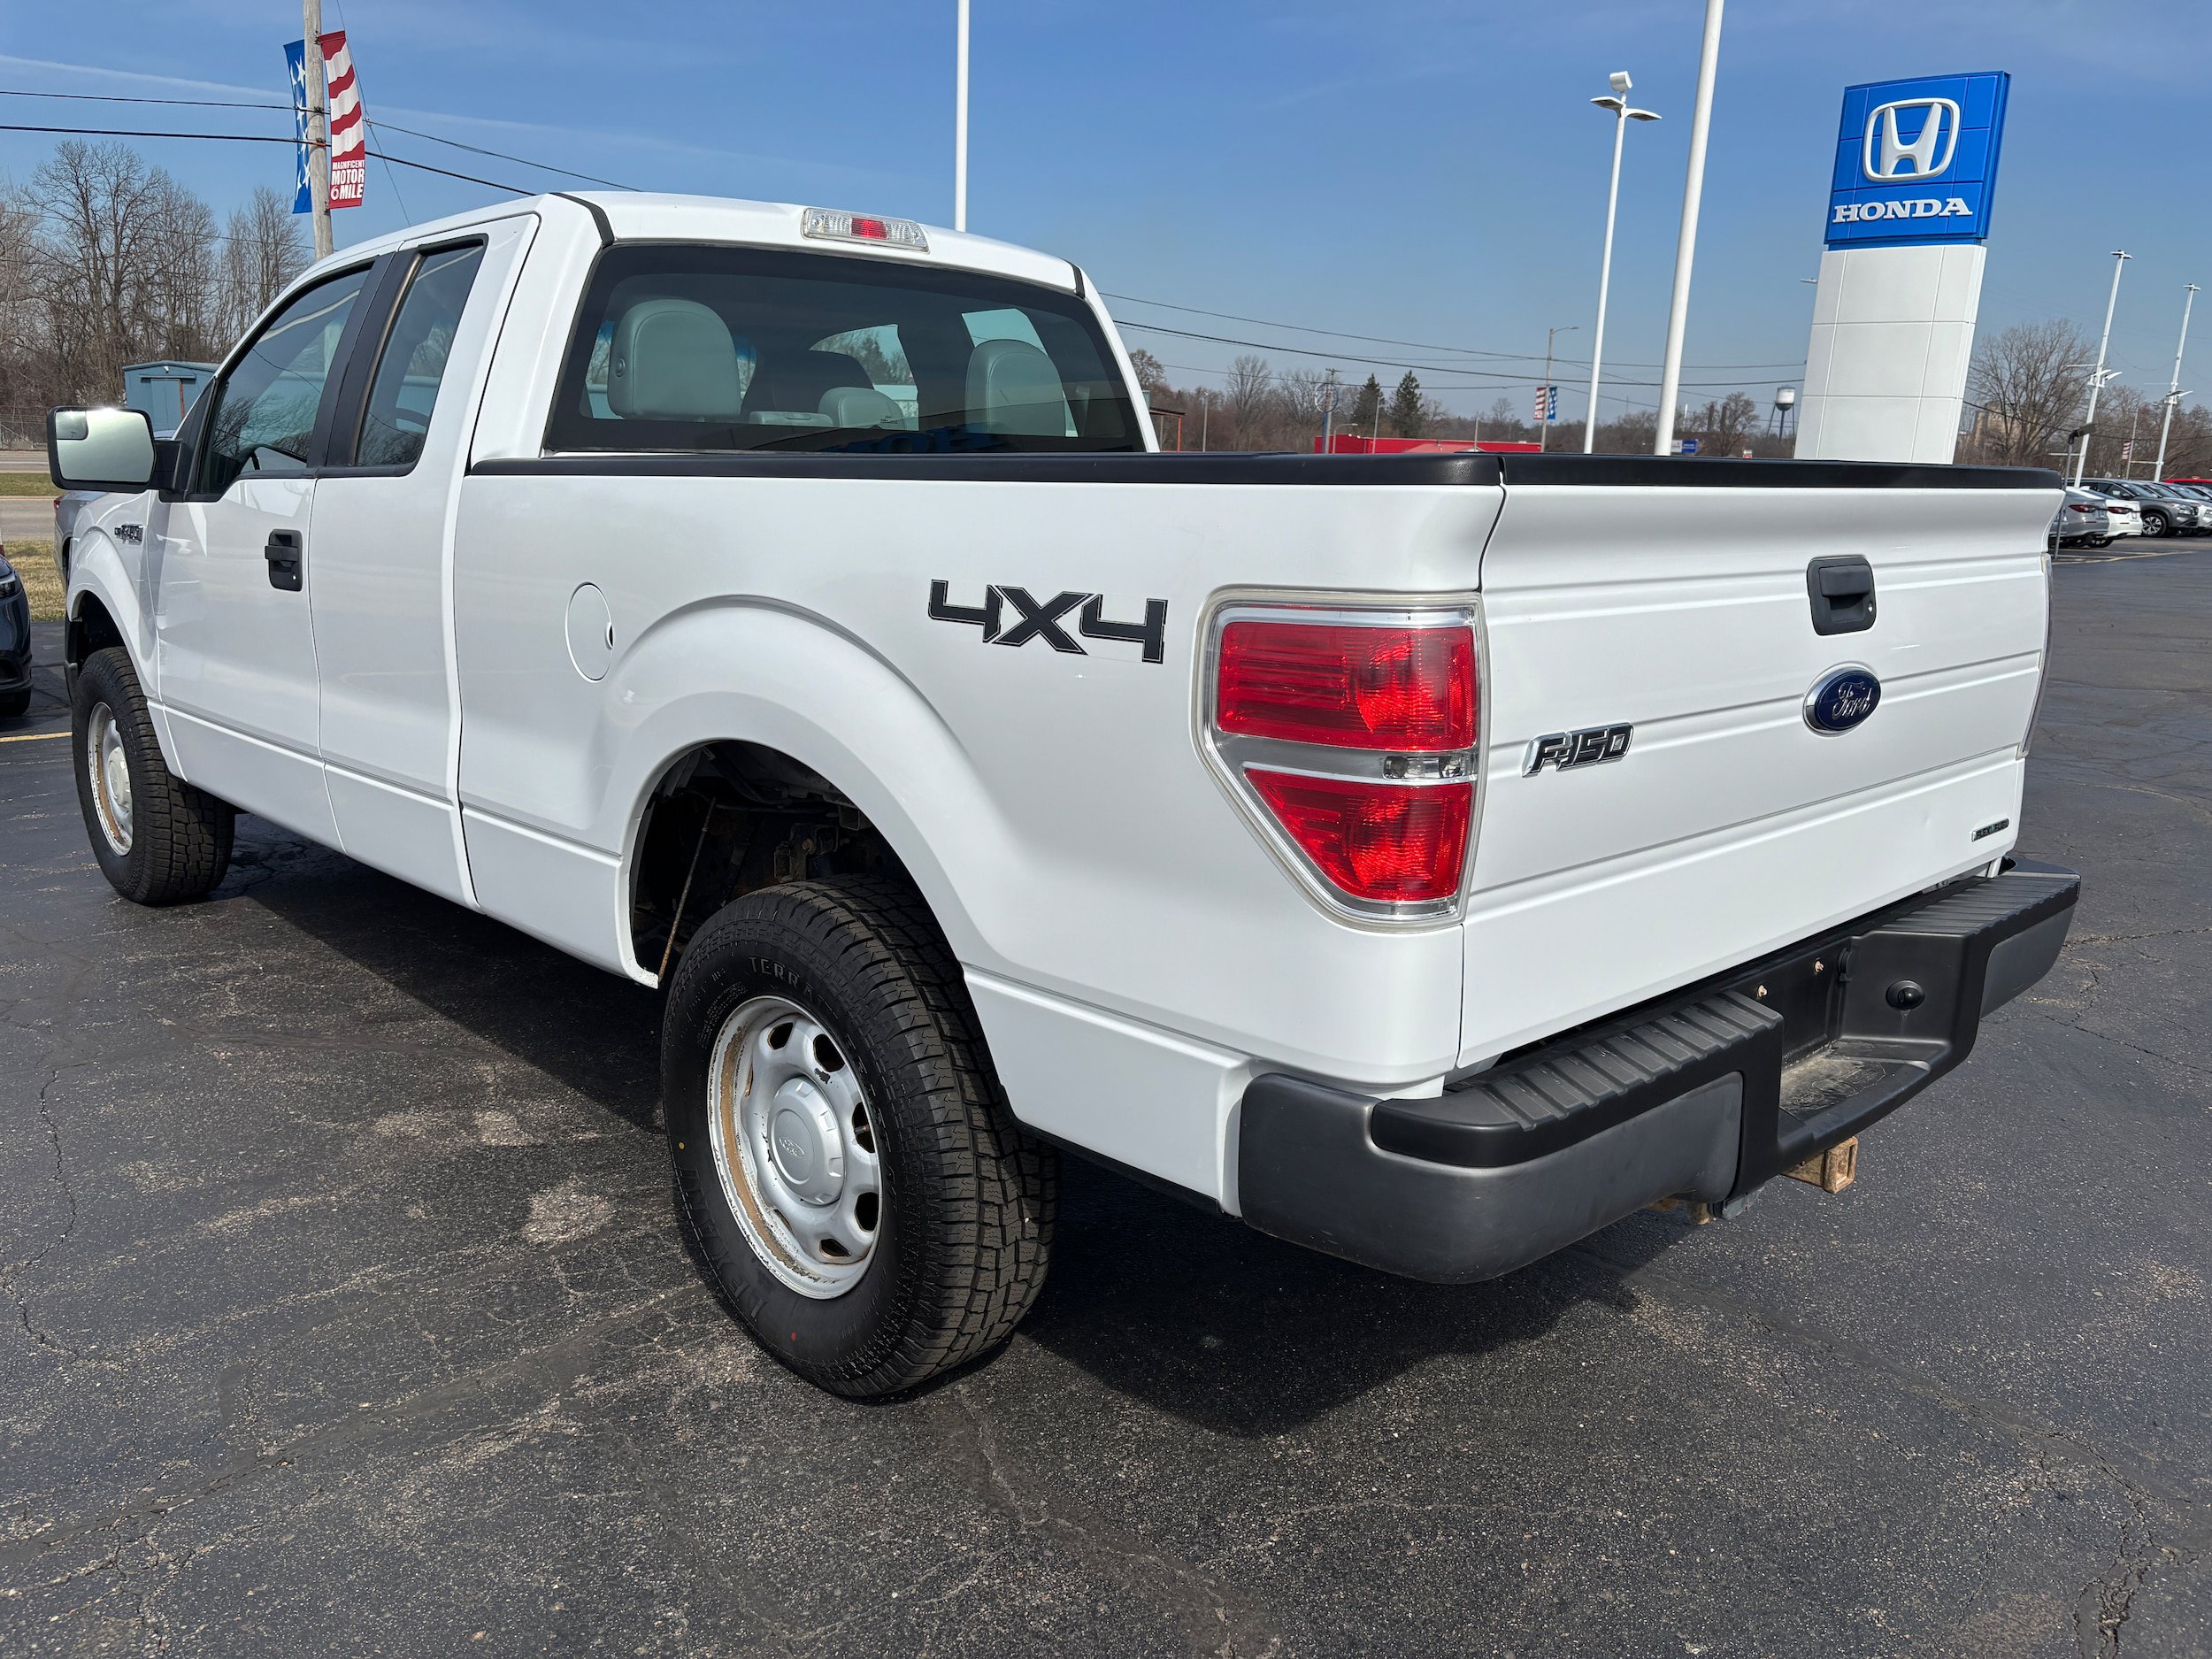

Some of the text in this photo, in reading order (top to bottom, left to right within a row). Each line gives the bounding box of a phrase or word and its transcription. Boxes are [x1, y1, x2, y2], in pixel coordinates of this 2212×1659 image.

[331, 168, 365, 186] MOTOR
[1832, 197, 1974, 223] HONDA
[1832, 680, 1873, 720] Ford
